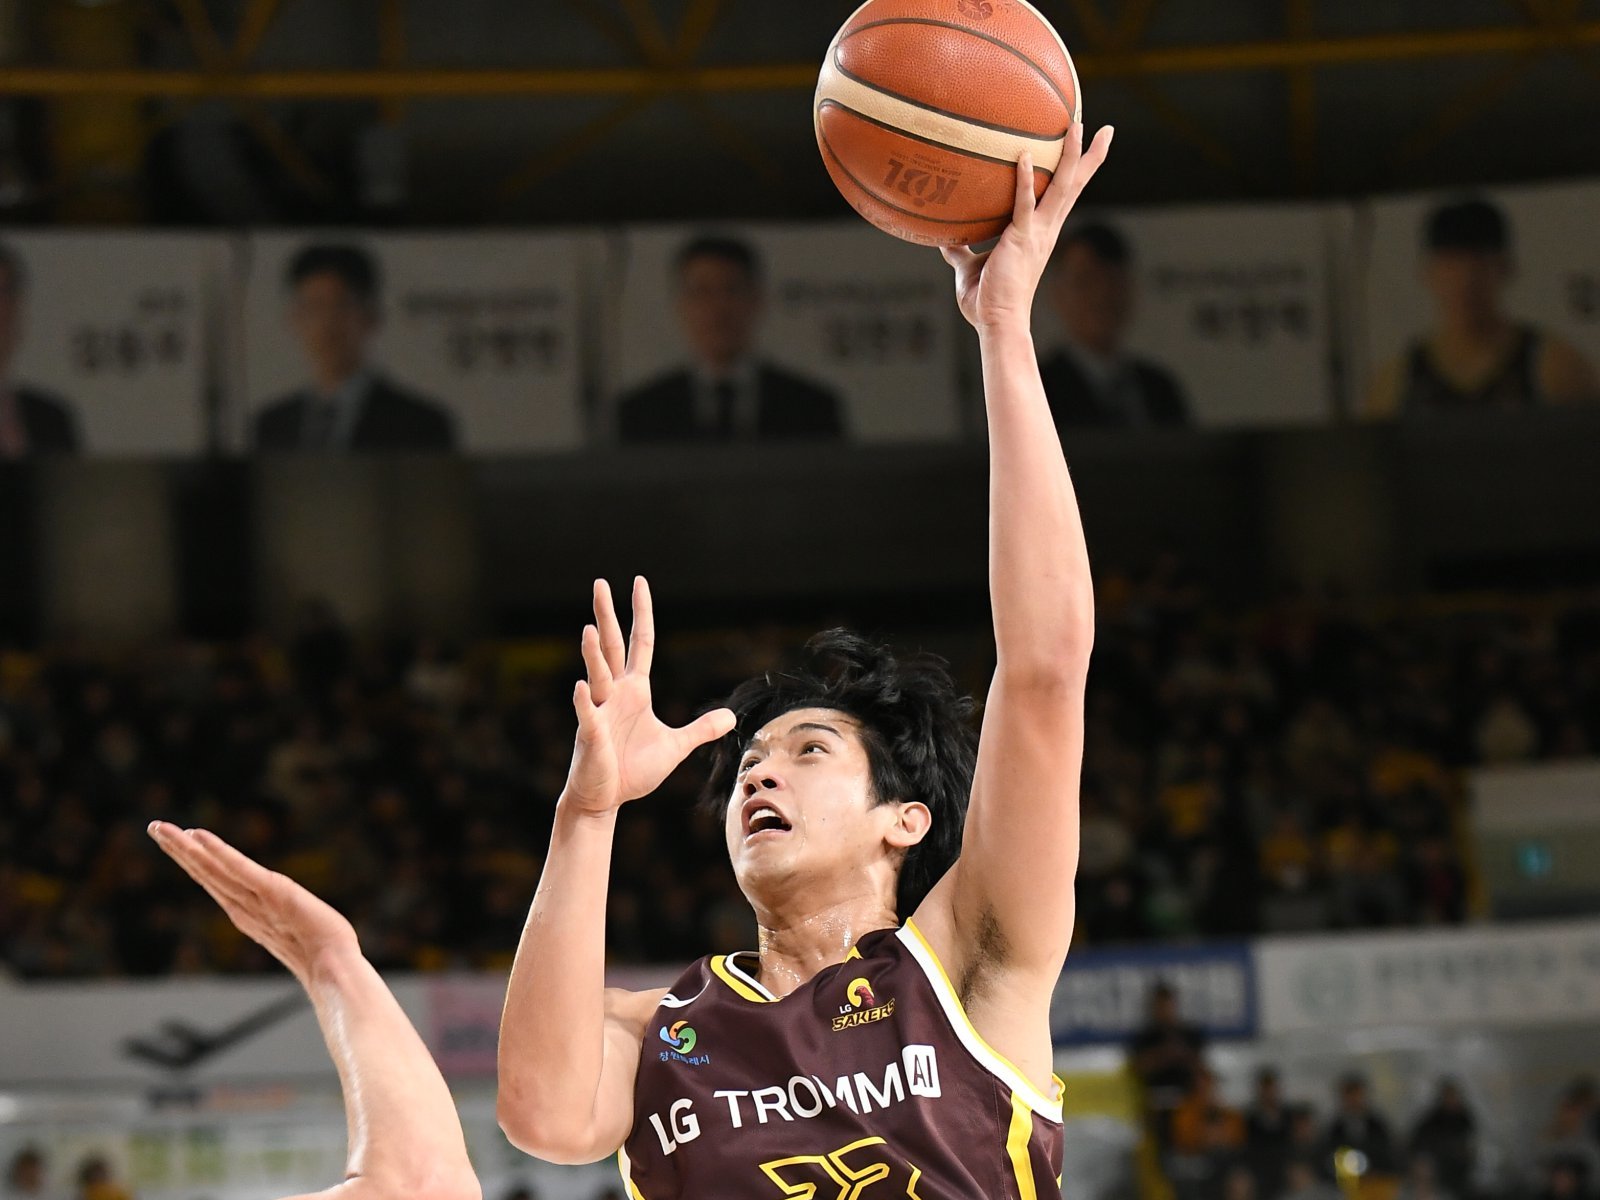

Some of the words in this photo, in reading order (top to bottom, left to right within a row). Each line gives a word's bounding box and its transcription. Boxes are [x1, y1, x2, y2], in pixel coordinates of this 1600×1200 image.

[883, 158, 959, 208] KBL
[831, 998, 896, 1032] SAKERS
[839, 1003, 853, 1015] LG
[648, 1098, 701, 1156] LG
[712, 1061, 906, 1129] TROMM
